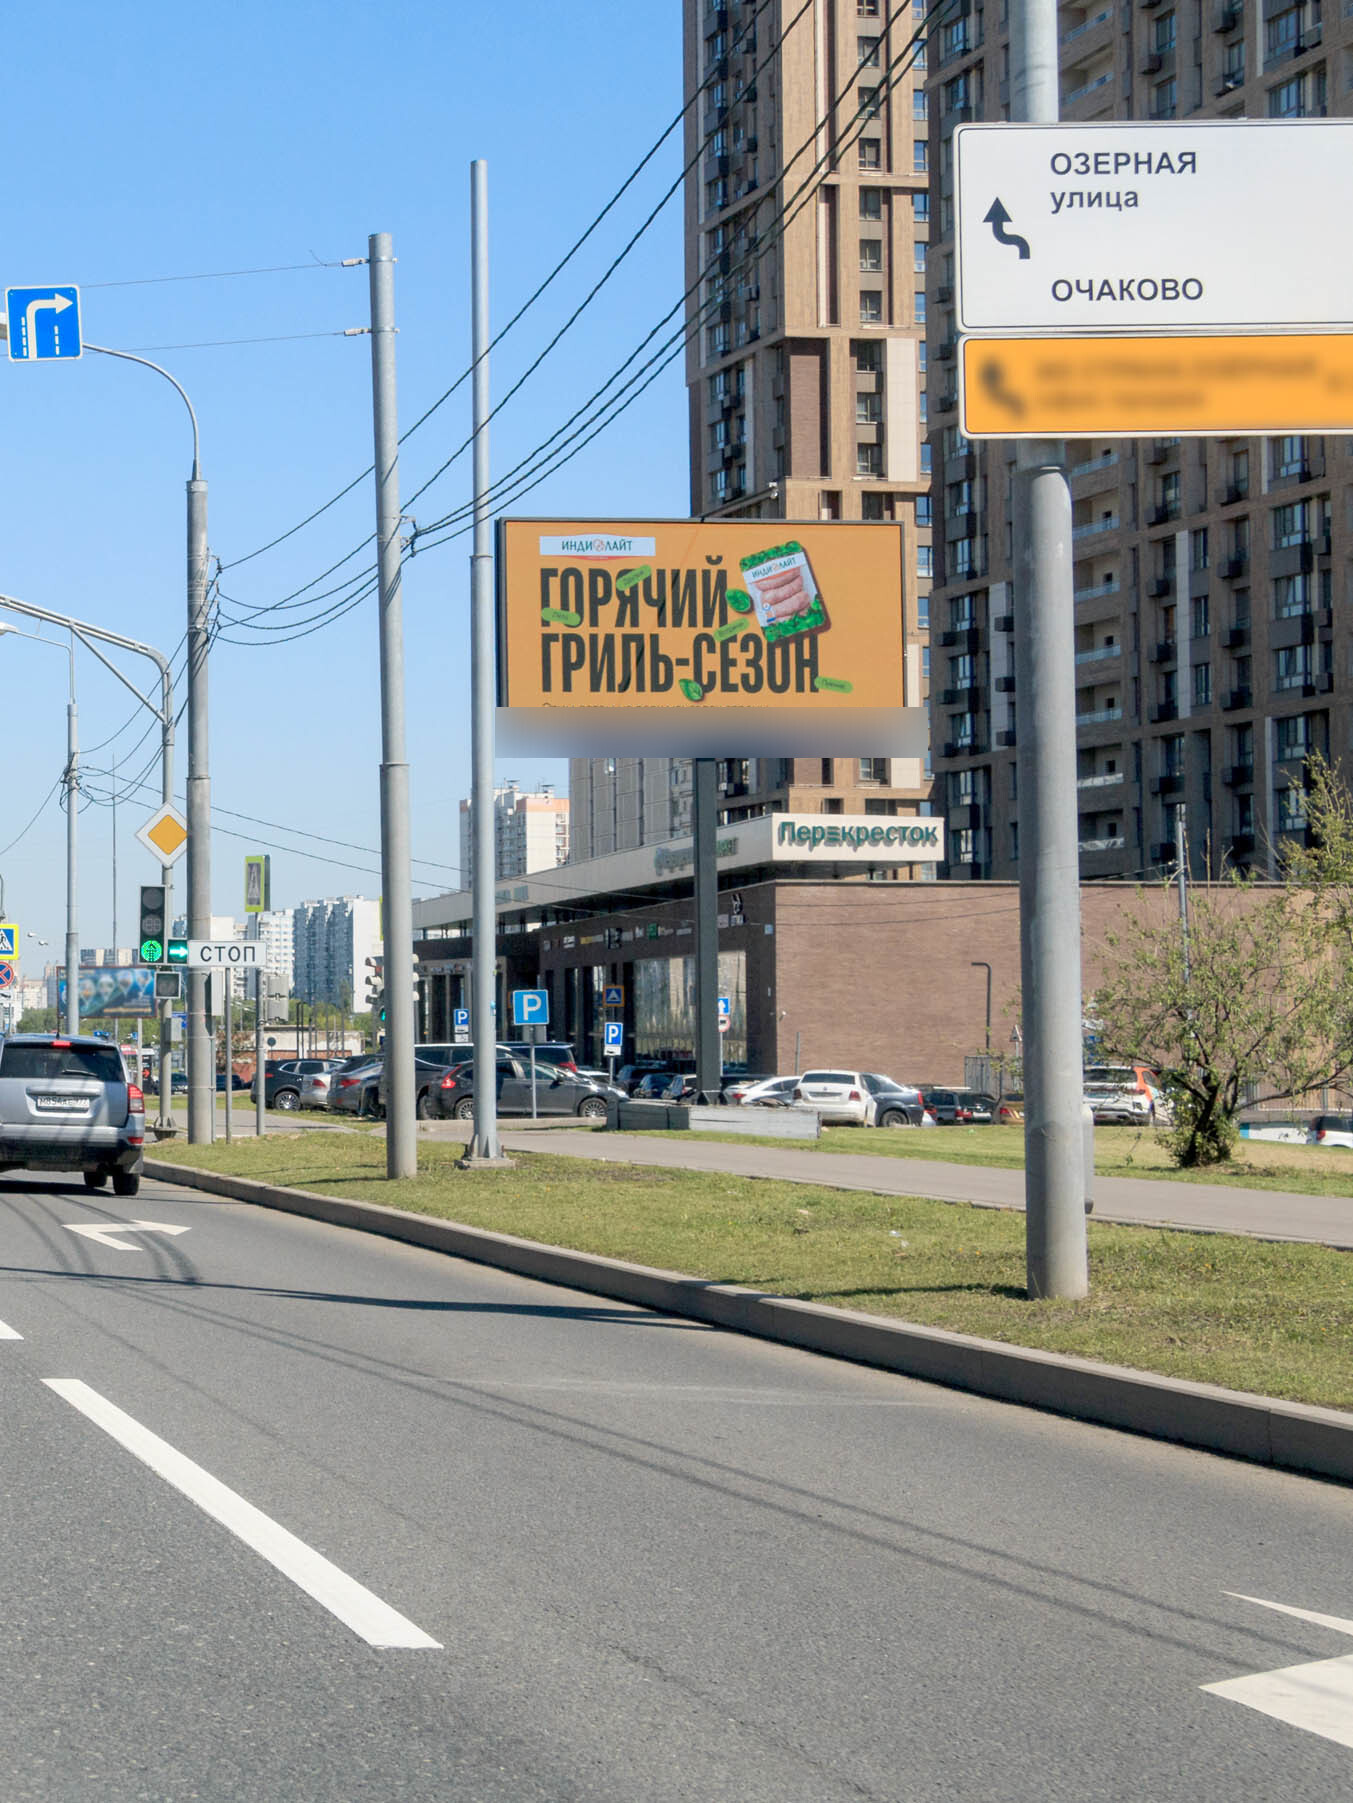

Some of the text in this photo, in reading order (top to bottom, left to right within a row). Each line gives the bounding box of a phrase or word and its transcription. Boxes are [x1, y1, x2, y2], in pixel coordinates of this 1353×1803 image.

[1050, 152, 1196, 175] ОЗЕРНАЯ
[1050, 190, 1139, 215] улица
[1051, 278, 1203, 302] ОЧАКОВО
[540, 555, 728, 628] ГОРЯЧИЙ
[541, 632, 820, 694] ГРИЛЬ-СЕЗОН
[200, 945, 256, 962] СТОП
